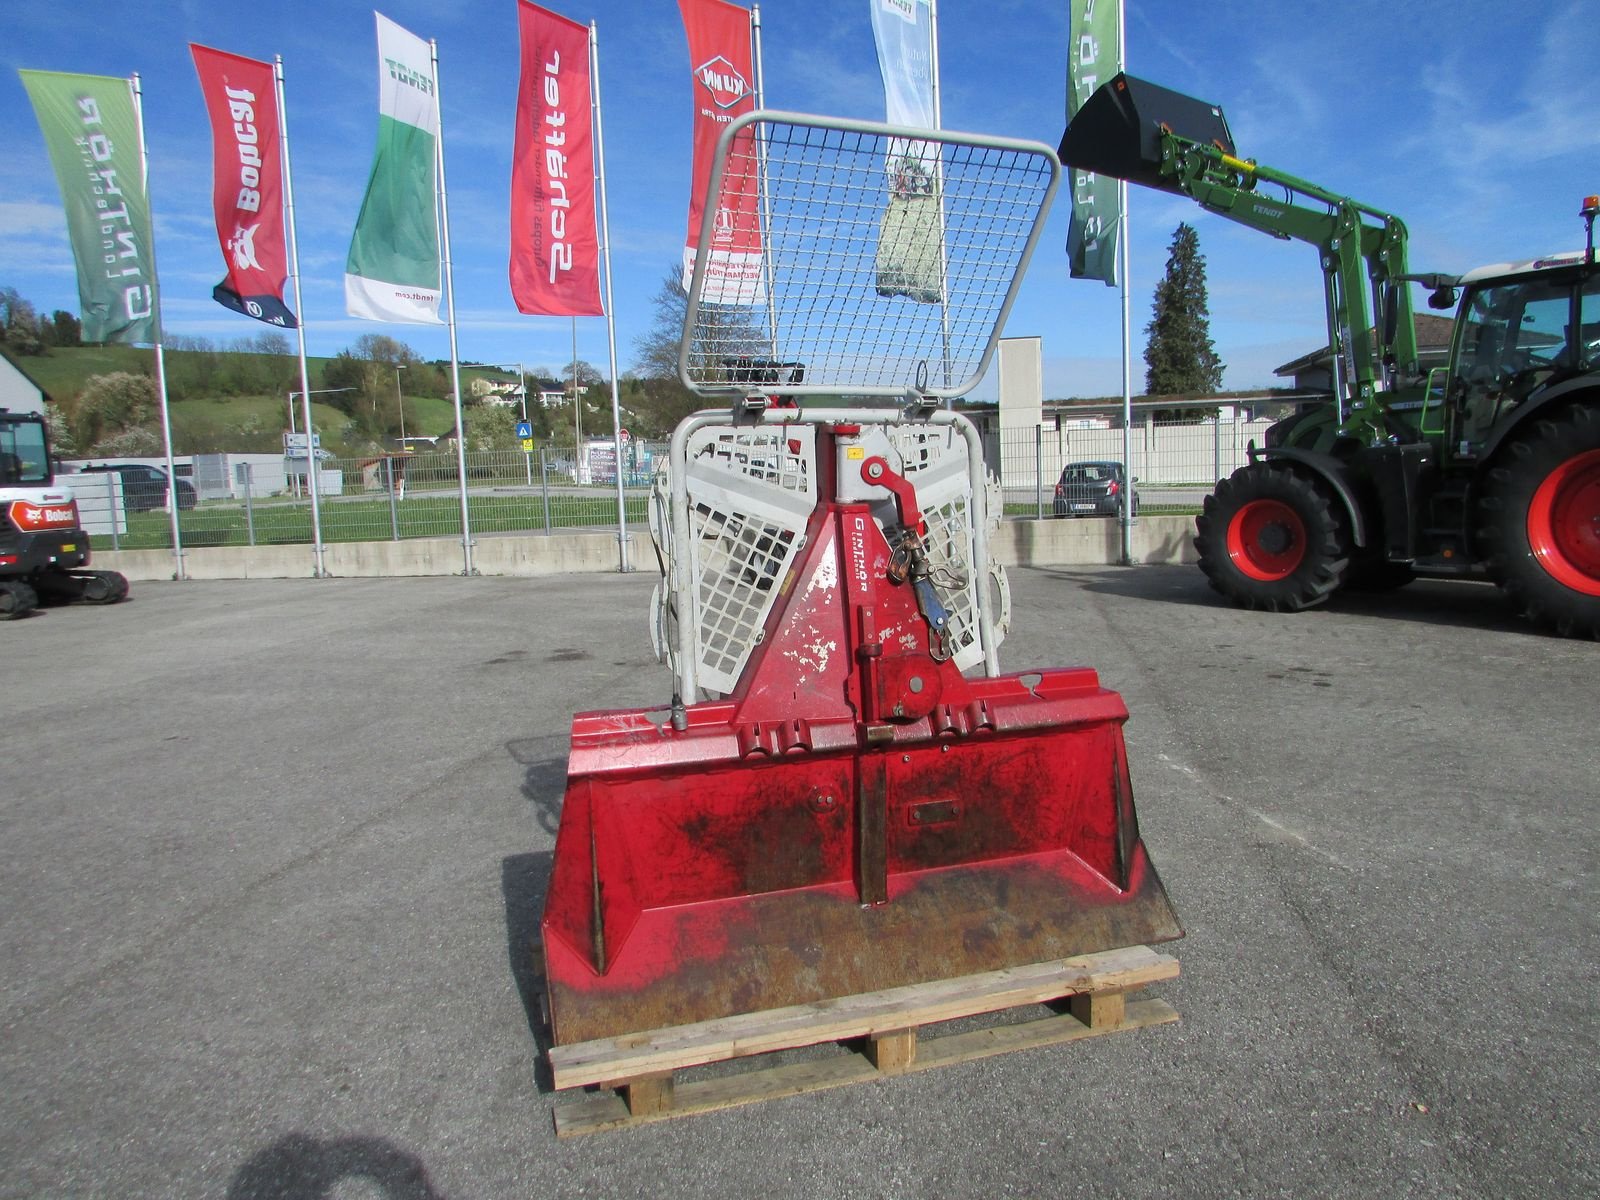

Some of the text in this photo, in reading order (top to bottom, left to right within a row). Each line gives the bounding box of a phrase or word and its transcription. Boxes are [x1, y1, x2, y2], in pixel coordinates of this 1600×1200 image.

[1253, 204, 1285, 219] FENDT
[45, 509, 74, 522] Bobcat
[854, 517, 868, 592] GINTHÖR
